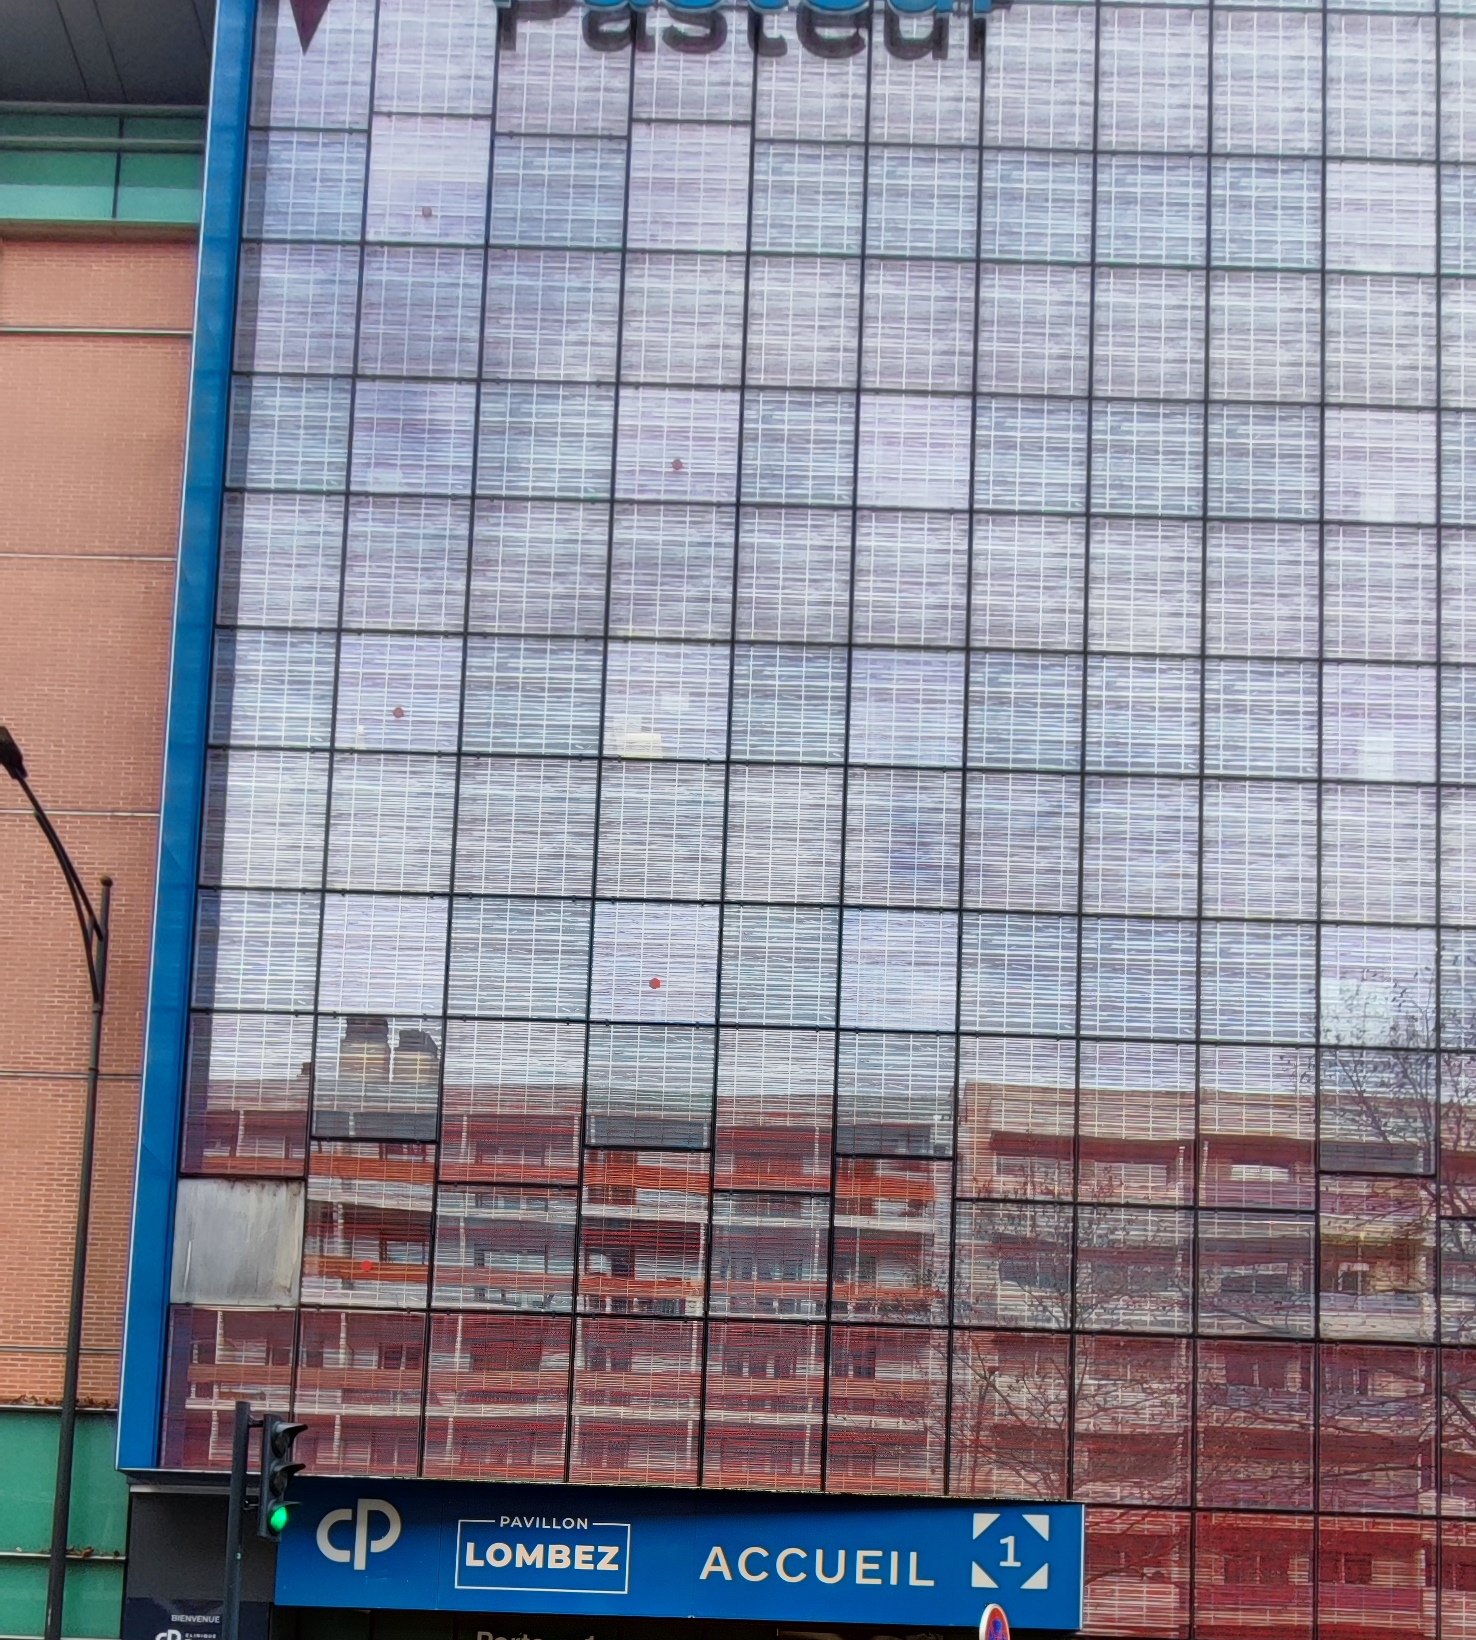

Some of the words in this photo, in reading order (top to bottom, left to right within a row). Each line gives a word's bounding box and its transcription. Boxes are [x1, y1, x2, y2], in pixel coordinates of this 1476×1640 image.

[500, 1516, 589, 1530] PAVILLON
[465, 1542, 620, 1571] LOMBEZ
[999, 1535, 1022, 1568] 1
[699, 1546, 935, 1587] ACCUEIL
[171, 1614, 220, 1624] BIENVENUE
